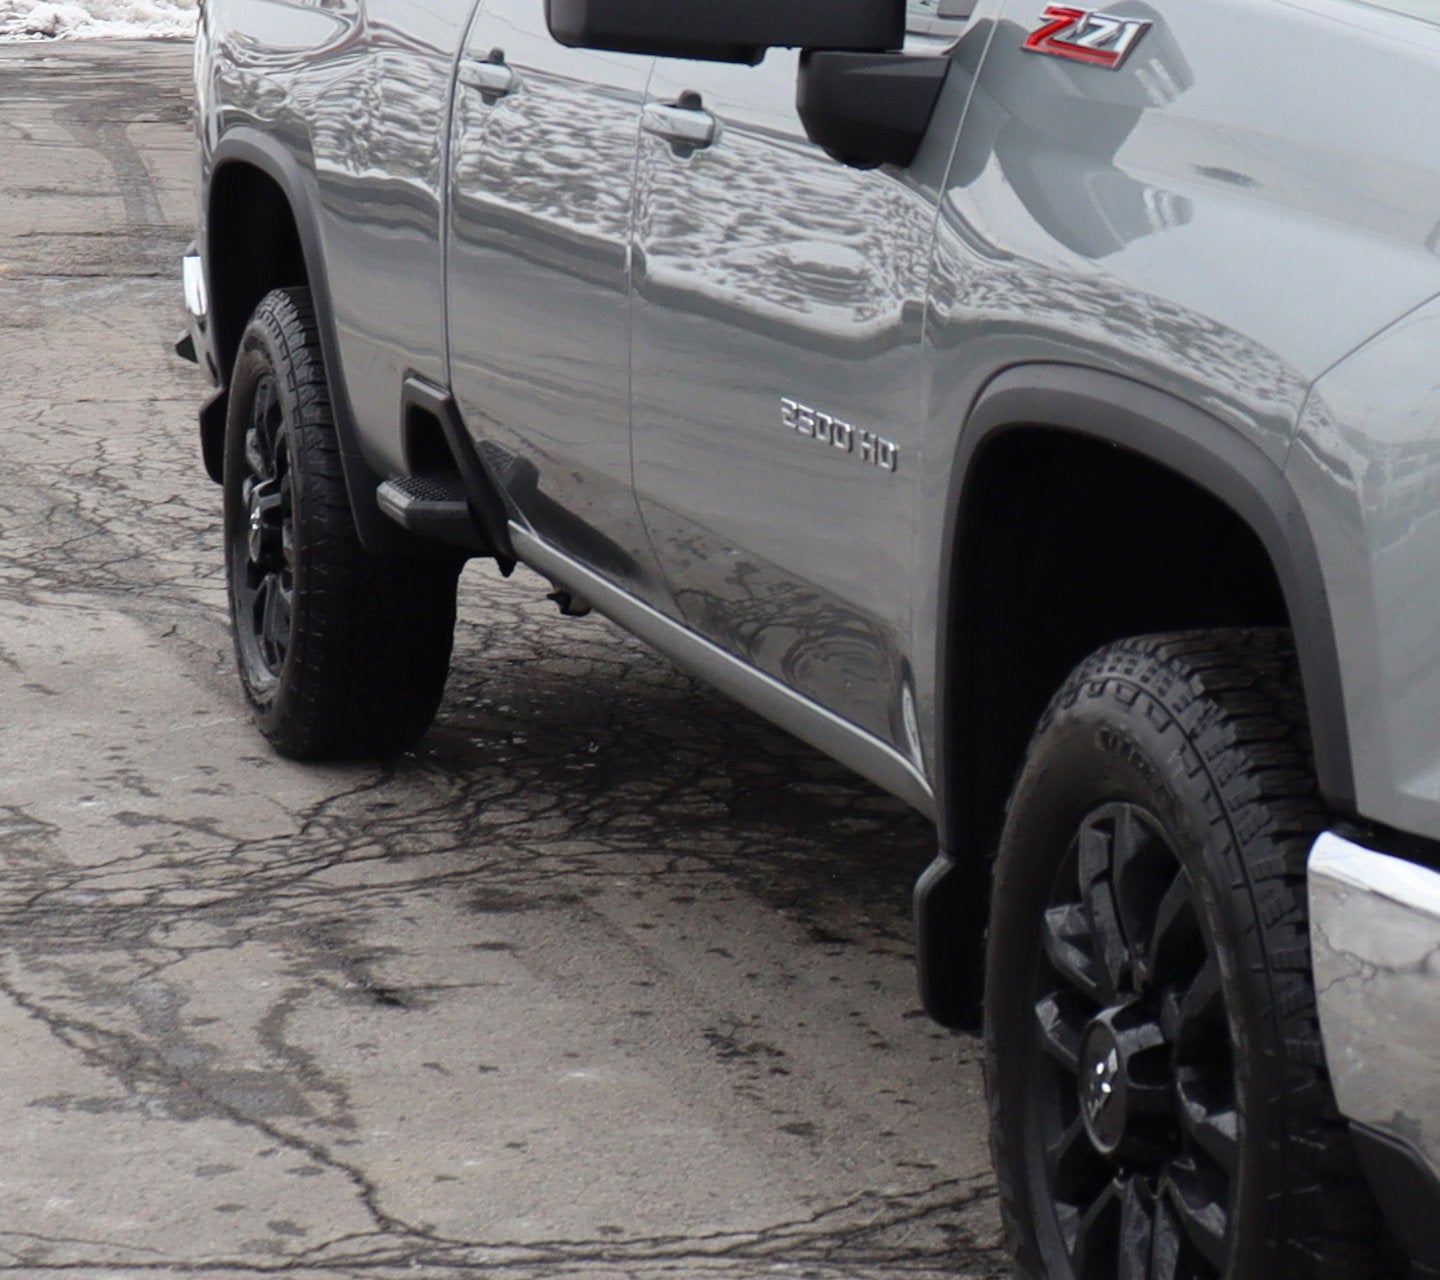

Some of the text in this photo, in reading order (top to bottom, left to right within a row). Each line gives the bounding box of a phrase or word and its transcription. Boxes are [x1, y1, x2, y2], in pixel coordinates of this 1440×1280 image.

[1021, 2, 1154, 69] Z71
[780, 396, 898, 473] 2500 HD
